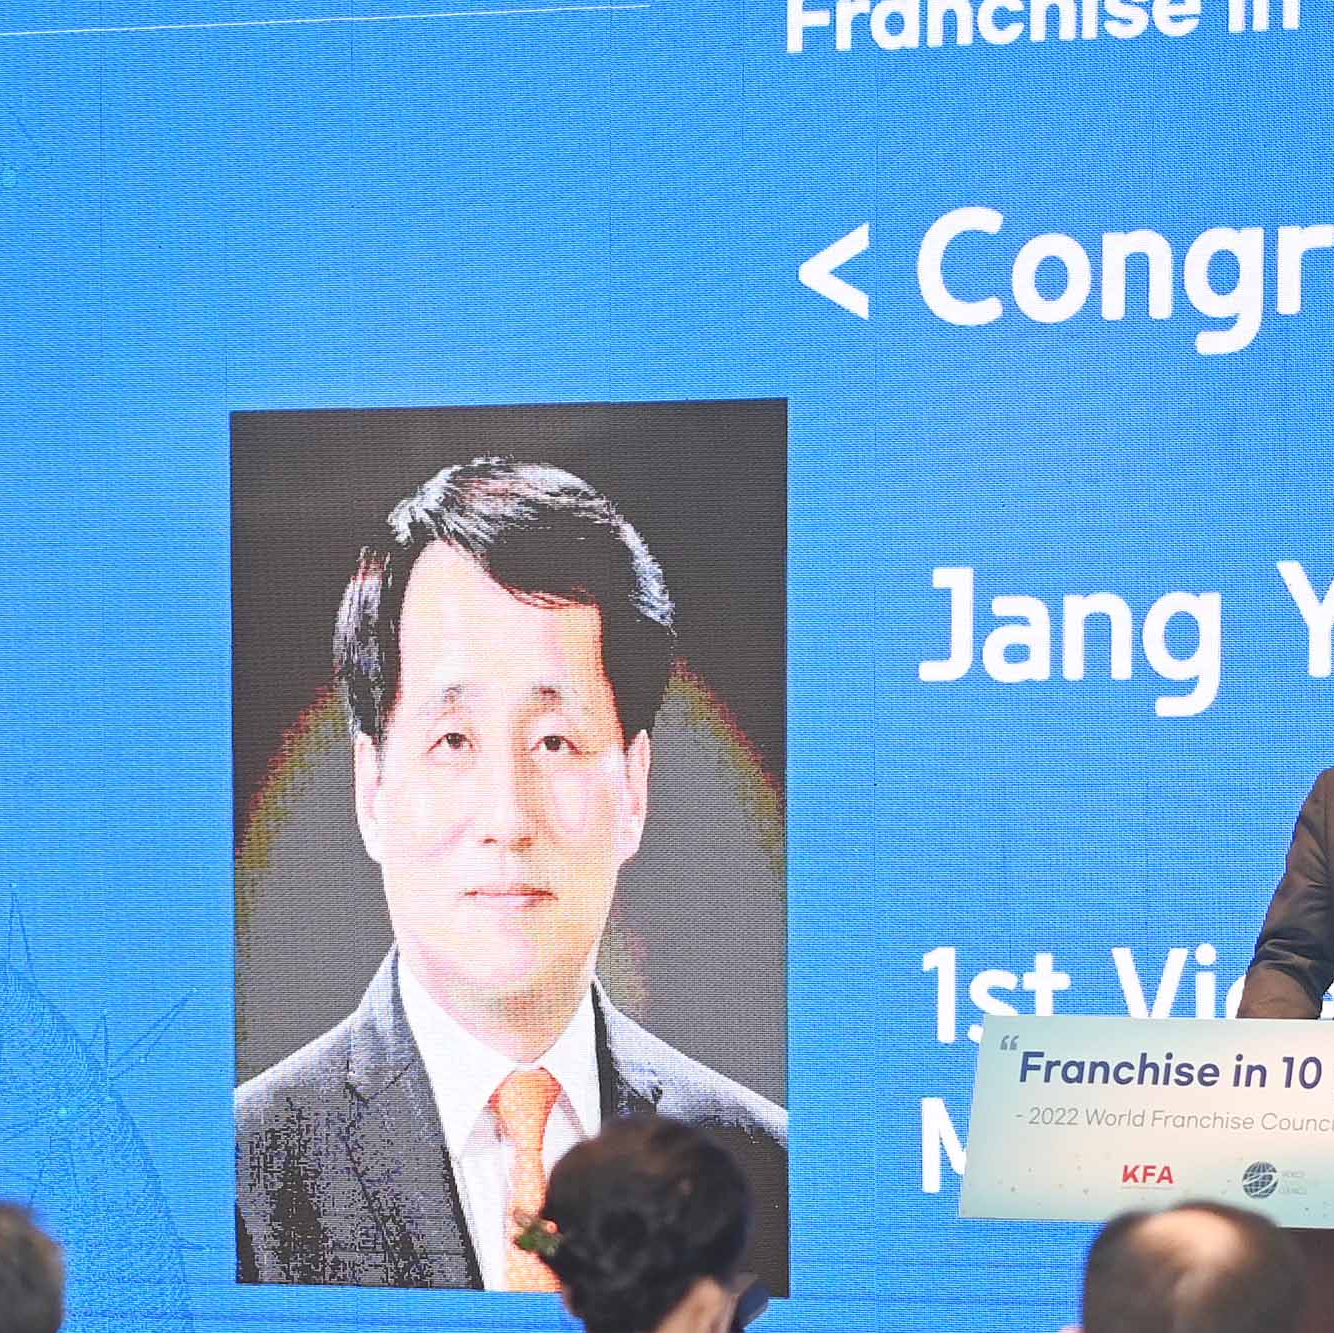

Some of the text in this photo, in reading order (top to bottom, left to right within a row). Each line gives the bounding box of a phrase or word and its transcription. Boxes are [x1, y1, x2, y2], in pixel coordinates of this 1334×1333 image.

[787, 0, 1202, 53] Franchise
[917, 566, 1223, 717] Jang
[922, 946, 1072, 1044] 1st
[1231, 1052, 1268, 1089] in
[1281, 1055, 1323, 1090] 10
[1027, 1106, 1080, 1126] 2022
[1084, 1106, 1147, 1128] World
[1150, 1109, 1255, 1131] Franchise
[1121, 1164, 1175, 1184] KFA
